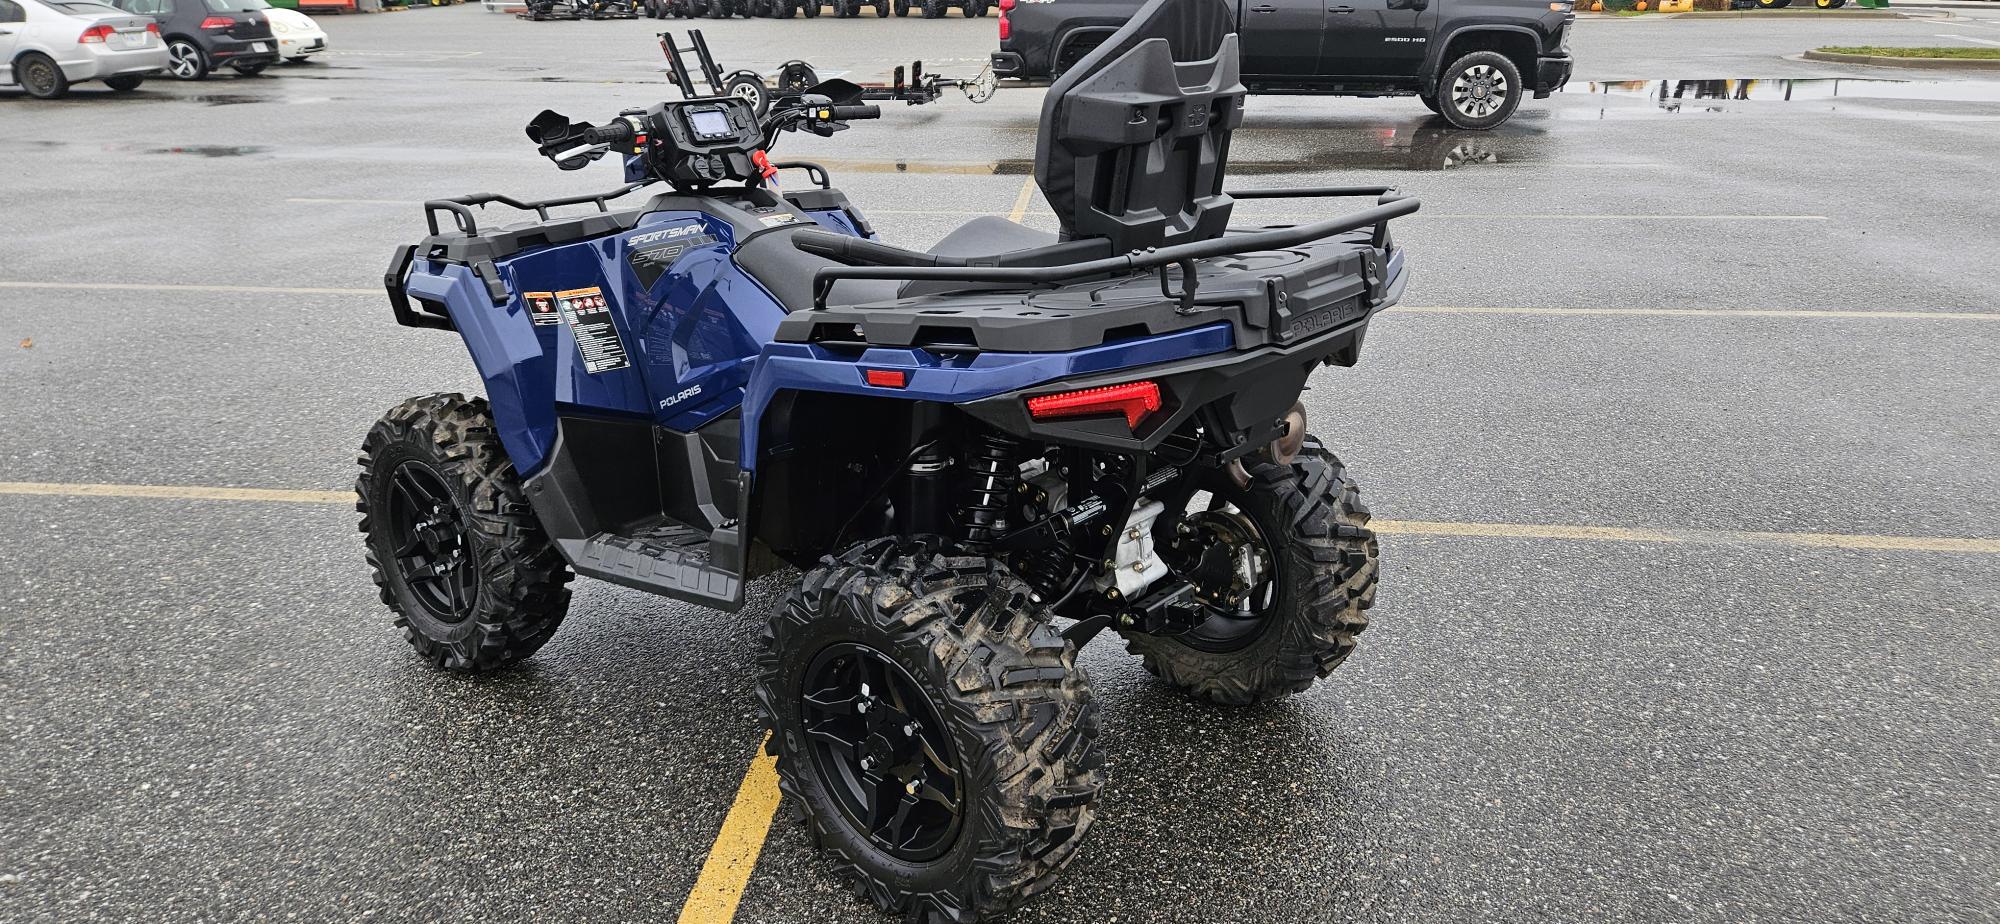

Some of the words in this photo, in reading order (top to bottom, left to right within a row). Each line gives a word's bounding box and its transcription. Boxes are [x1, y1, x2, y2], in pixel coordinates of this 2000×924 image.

[627, 222, 708, 246] SPORTSMAN
[632, 245, 684, 265] 570
[1292, 303, 1354, 337] POLARIS
[660, 384, 702, 410] POLARIS
